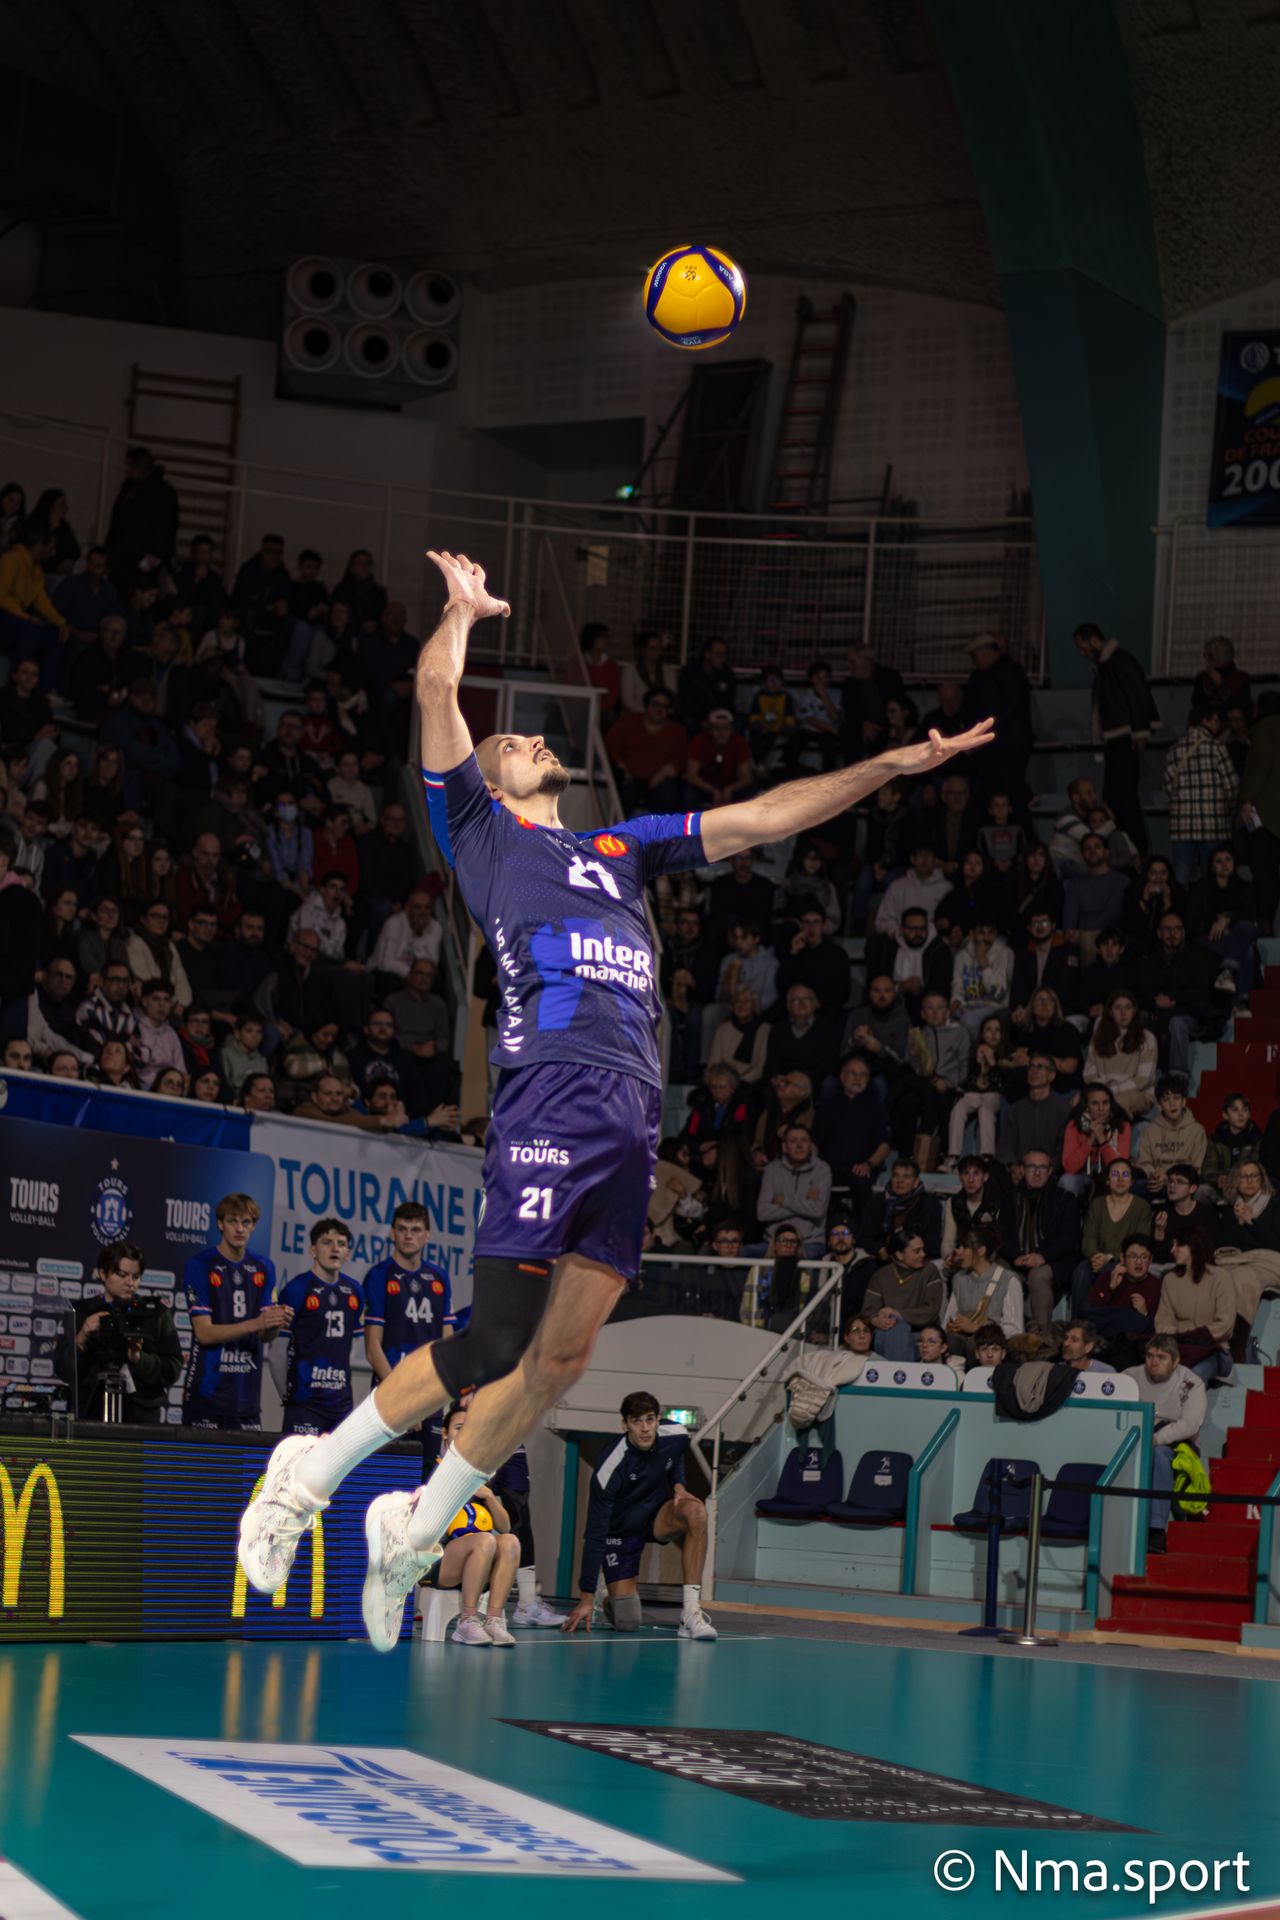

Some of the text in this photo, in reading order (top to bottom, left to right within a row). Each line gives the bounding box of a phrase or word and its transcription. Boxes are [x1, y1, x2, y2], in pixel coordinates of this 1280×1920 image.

[509, 1146, 570, 1166] TOURS
[9, 1177, 59, 1214] TOURS
[98, 1177, 129, 1196] TOURS
[166, 1198, 210, 1232] TOURS
[519, 1186, 553, 1220] 21
[281, 1222, 306, 1255] LE
[233, 1290, 247, 1319] 8
[405, 1296, 434, 1324] 44
[324, 1310, 345, 1338] 13
[605, 1552, 620, 1568] 12
[216, 1774, 520, 1866] TOURAINE
